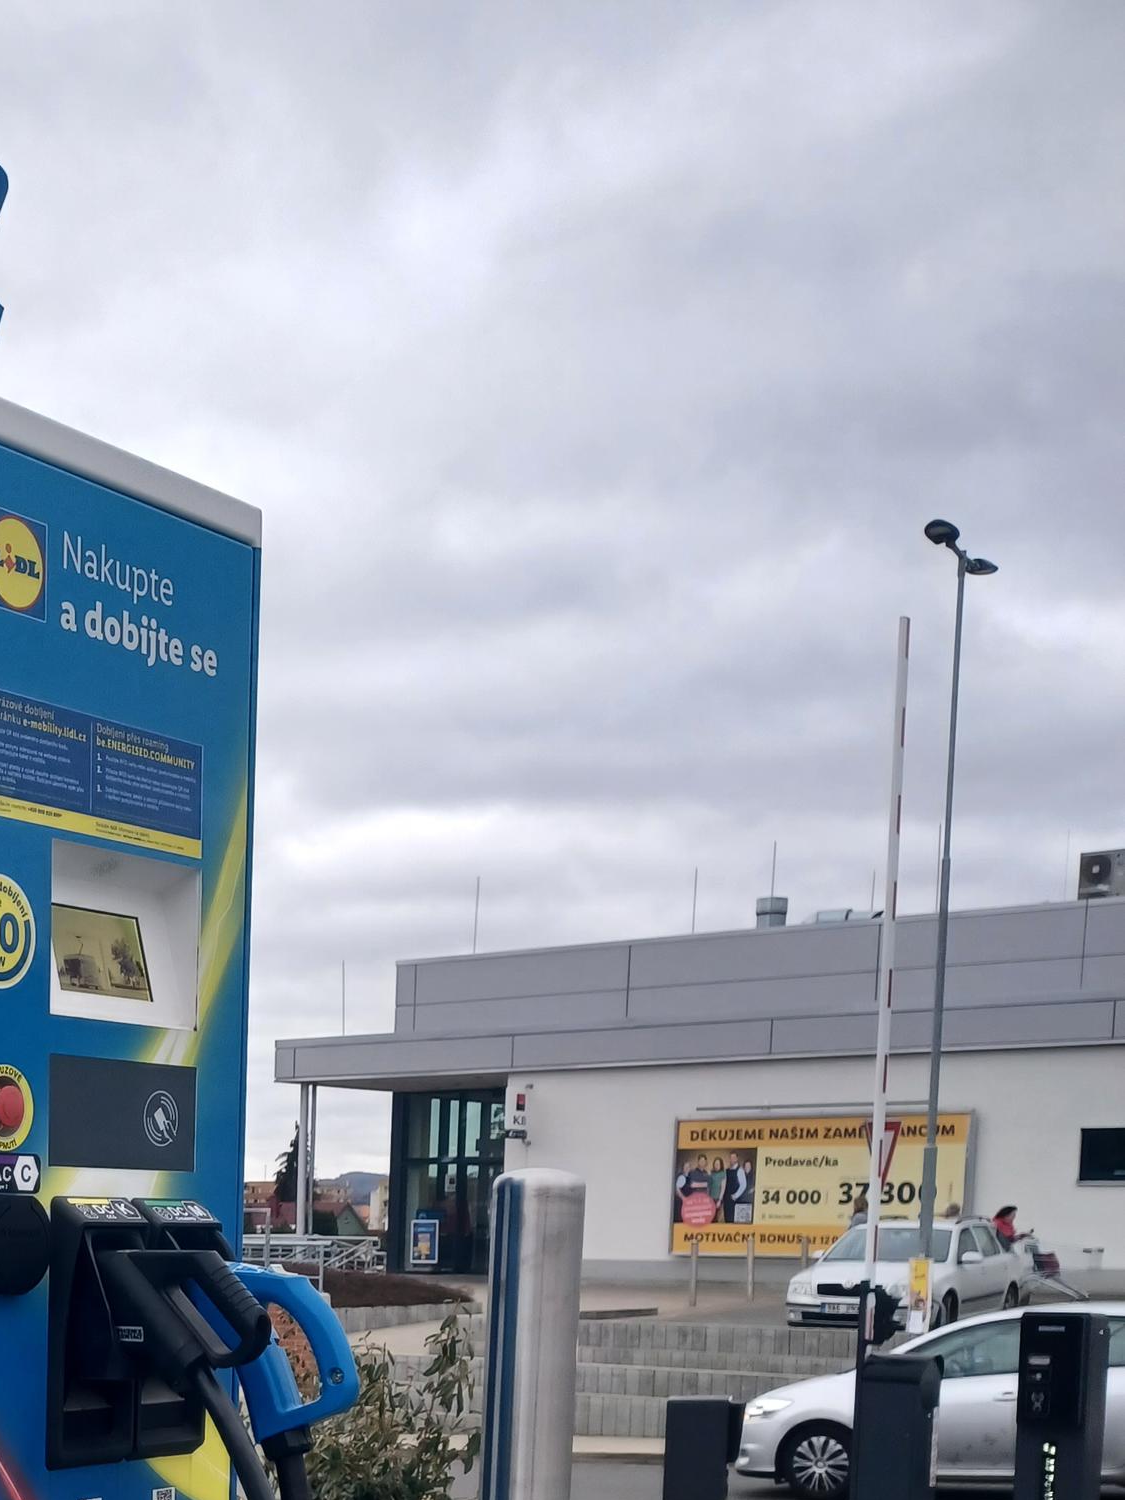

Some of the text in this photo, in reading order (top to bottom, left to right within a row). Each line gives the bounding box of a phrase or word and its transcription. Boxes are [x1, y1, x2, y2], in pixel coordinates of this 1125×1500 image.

[62, 530, 174, 606] Nakupte
[60, 601, 217, 677] a dobijte se
[23, 718, 87, 742] e-mobility.lidl.cz
[126, 732, 141, 745] přes
[142, 738, 169, 753] roaming
[96, 735, 196, 770] be.ENERGISED.COMMUNITY
[690, 1128, 765, 1142] DĚKUJEME
[769, 1126, 818, 1140] NAŠIM
[764, 1155, 839, 1169] Prodavač/ka
[20, 1165, 32, 1183] C
[762, 1190, 822, 1205] 34 000
[838, 1183, 870, 1205] 37
[92, 1204, 115, 1214] DC
[115, 1203, 135, 1215] K
[166, 1206, 188, 1216] DC
